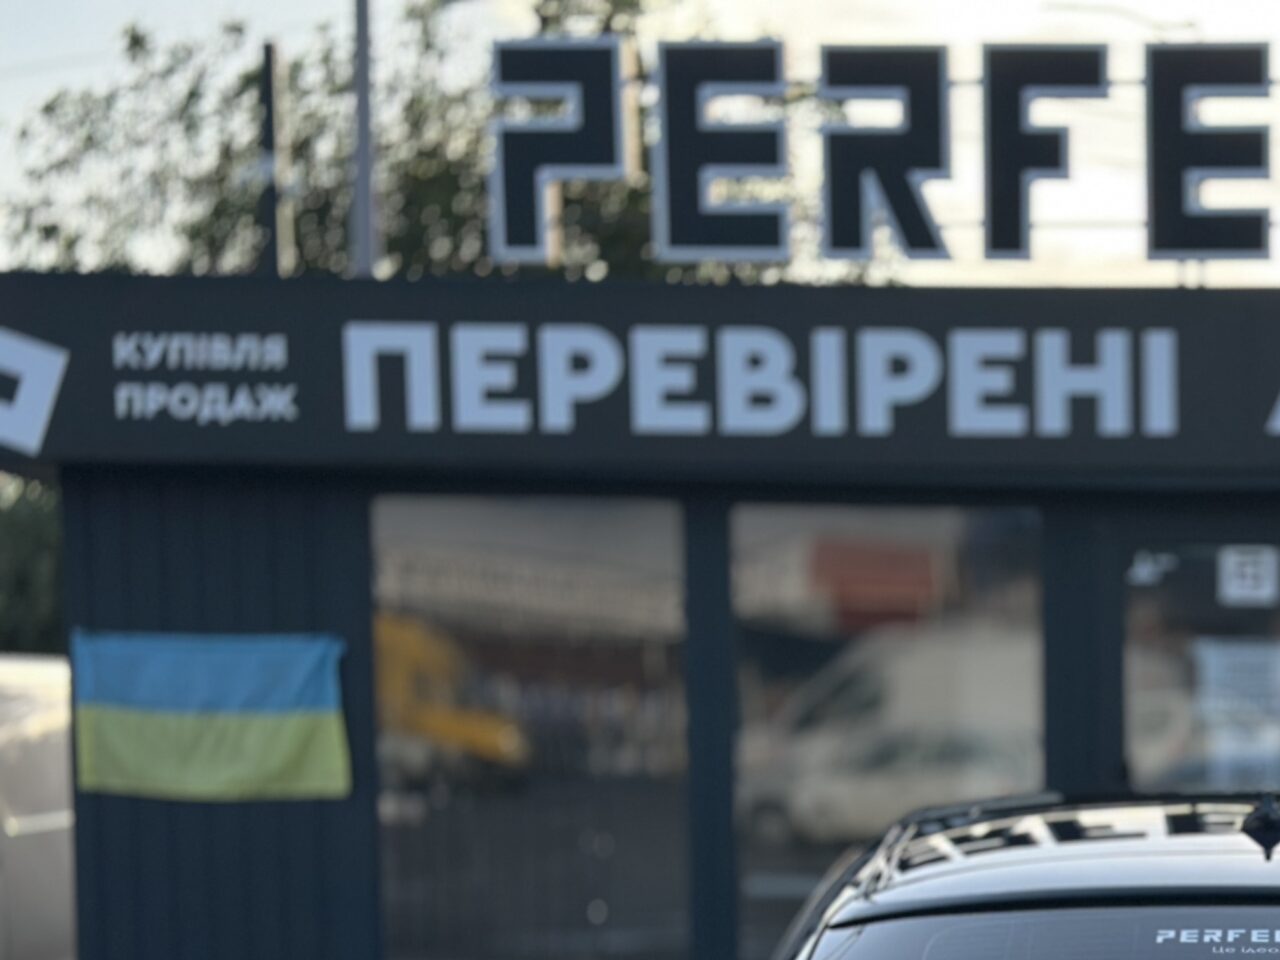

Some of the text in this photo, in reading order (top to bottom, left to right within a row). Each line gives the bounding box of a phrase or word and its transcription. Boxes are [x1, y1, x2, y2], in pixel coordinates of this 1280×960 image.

[113, 332, 289, 370] КУПІВЛЯ
[342, 321, 1180, 438] ПЕРЕВІРЕНІ
[114, 382, 299, 425] ПРОДАЖ
